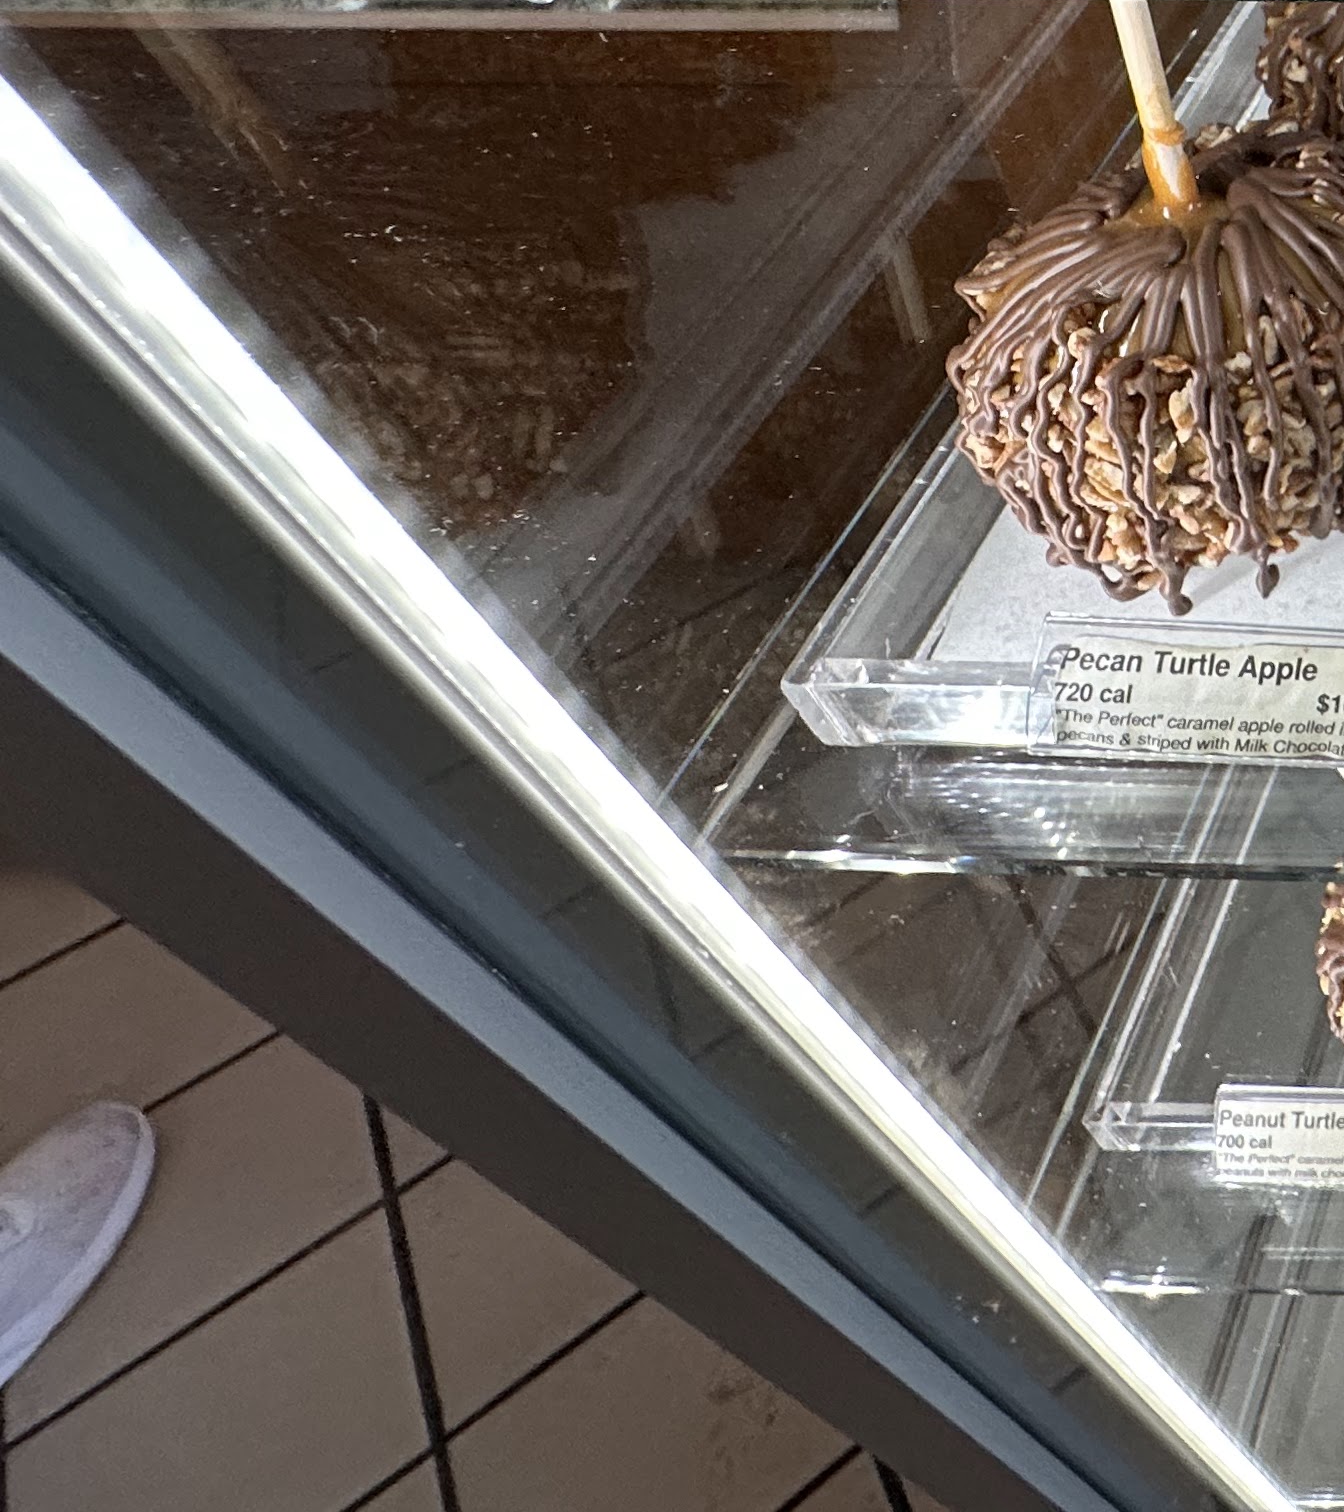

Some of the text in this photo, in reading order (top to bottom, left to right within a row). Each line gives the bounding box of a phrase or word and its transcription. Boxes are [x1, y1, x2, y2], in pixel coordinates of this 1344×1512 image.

[1059, 646, 1319, 686] Pecan Turtle Apple
[1054, 682, 1093, 703] 720
[1100, 685, 1133, 705] cal
[1055, 708, 1094, 724] "The
[1098, 710, 1164, 729] Perfect"
[1167, 716, 1234, 732] caramel
[1238, 719, 1284, 736] apple
[1288, 720, 1335, 736] rolled
[1056, 730, 1115, 746] pecans
[1119, 732, 1131, 746] &
[1137, 732, 1192, 752] striped
[1196, 736, 1230, 754] with
[1234, 739, 1268, 754] Milk
[1219, 1109, 1286, 1129] Peanut
[1217, 1134, 1245, 1149] 700
[1249, 1134, 1273, 1150] cal
[1297, 1155, 1344, 1166] caramel
[1267, 1167, 1292, 1177] with
